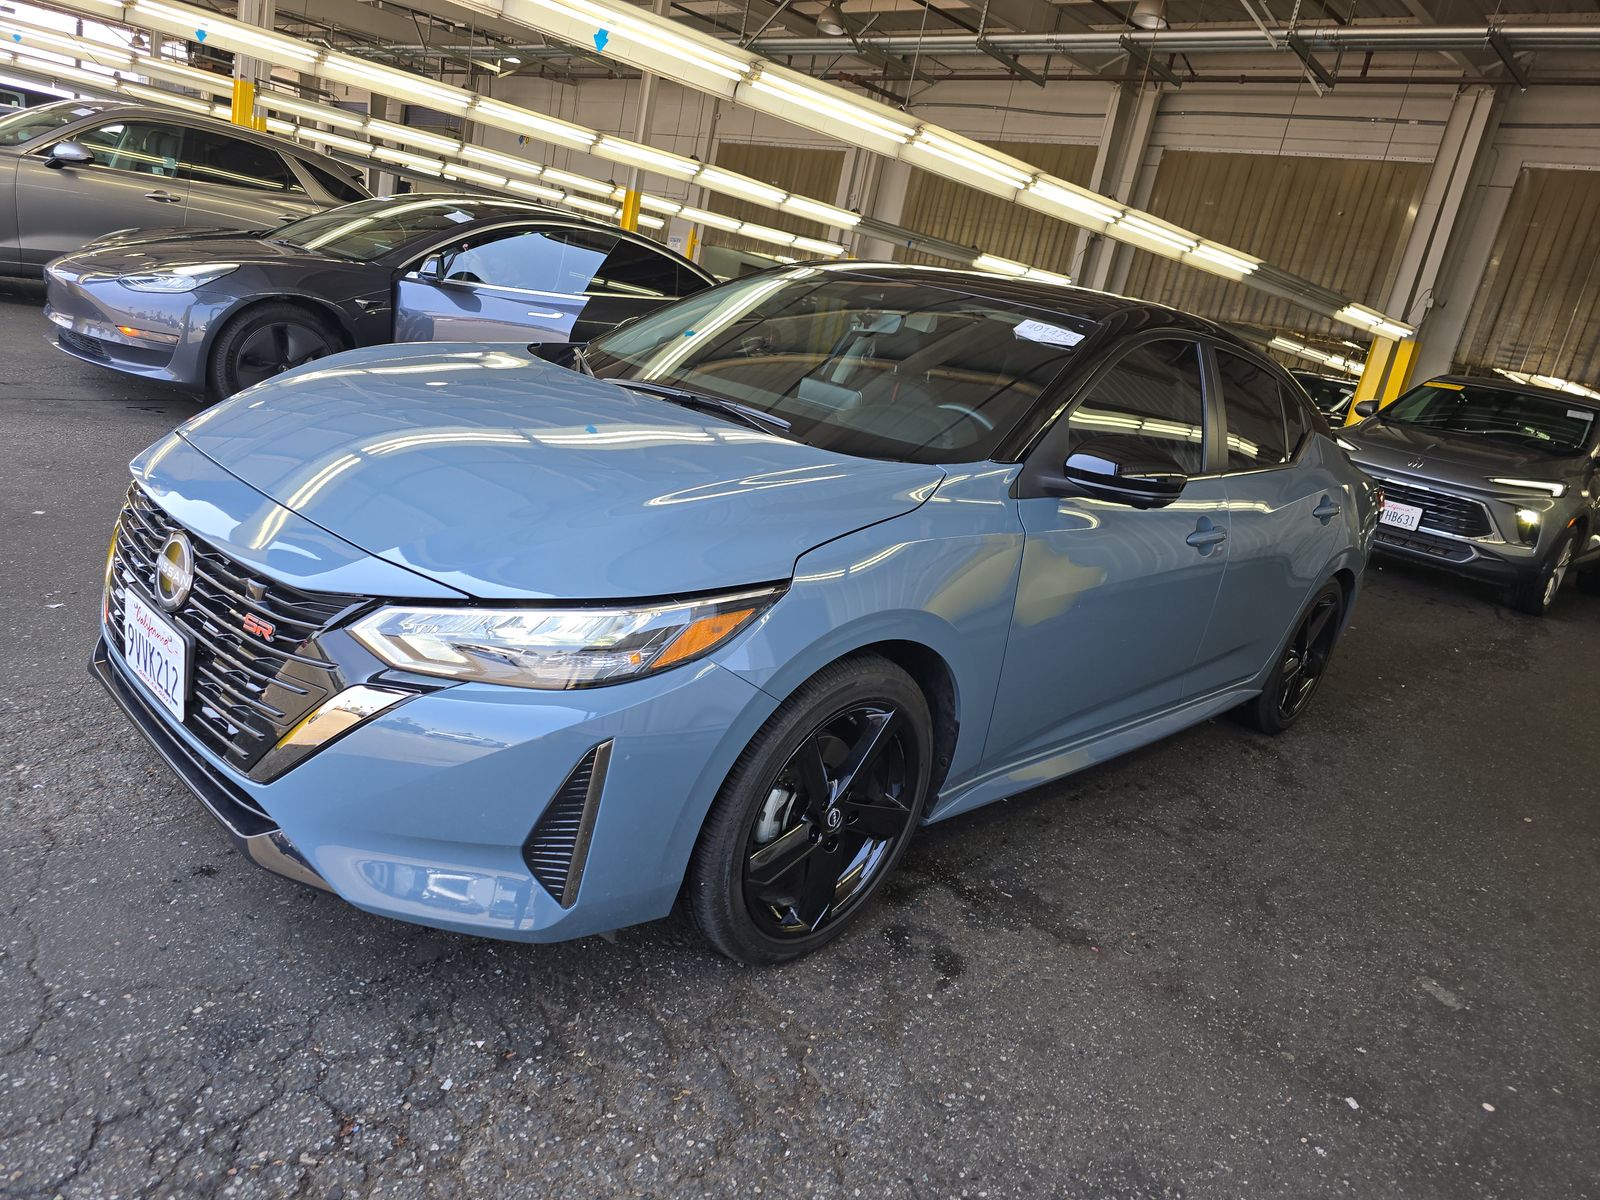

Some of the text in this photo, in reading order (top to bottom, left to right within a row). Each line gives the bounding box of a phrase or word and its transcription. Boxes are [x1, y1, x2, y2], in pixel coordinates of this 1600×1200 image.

[135, 605, 173, 654] California
[243, 612, 276, 642] SR
[128, 623, 179, 706] 9VVK212
